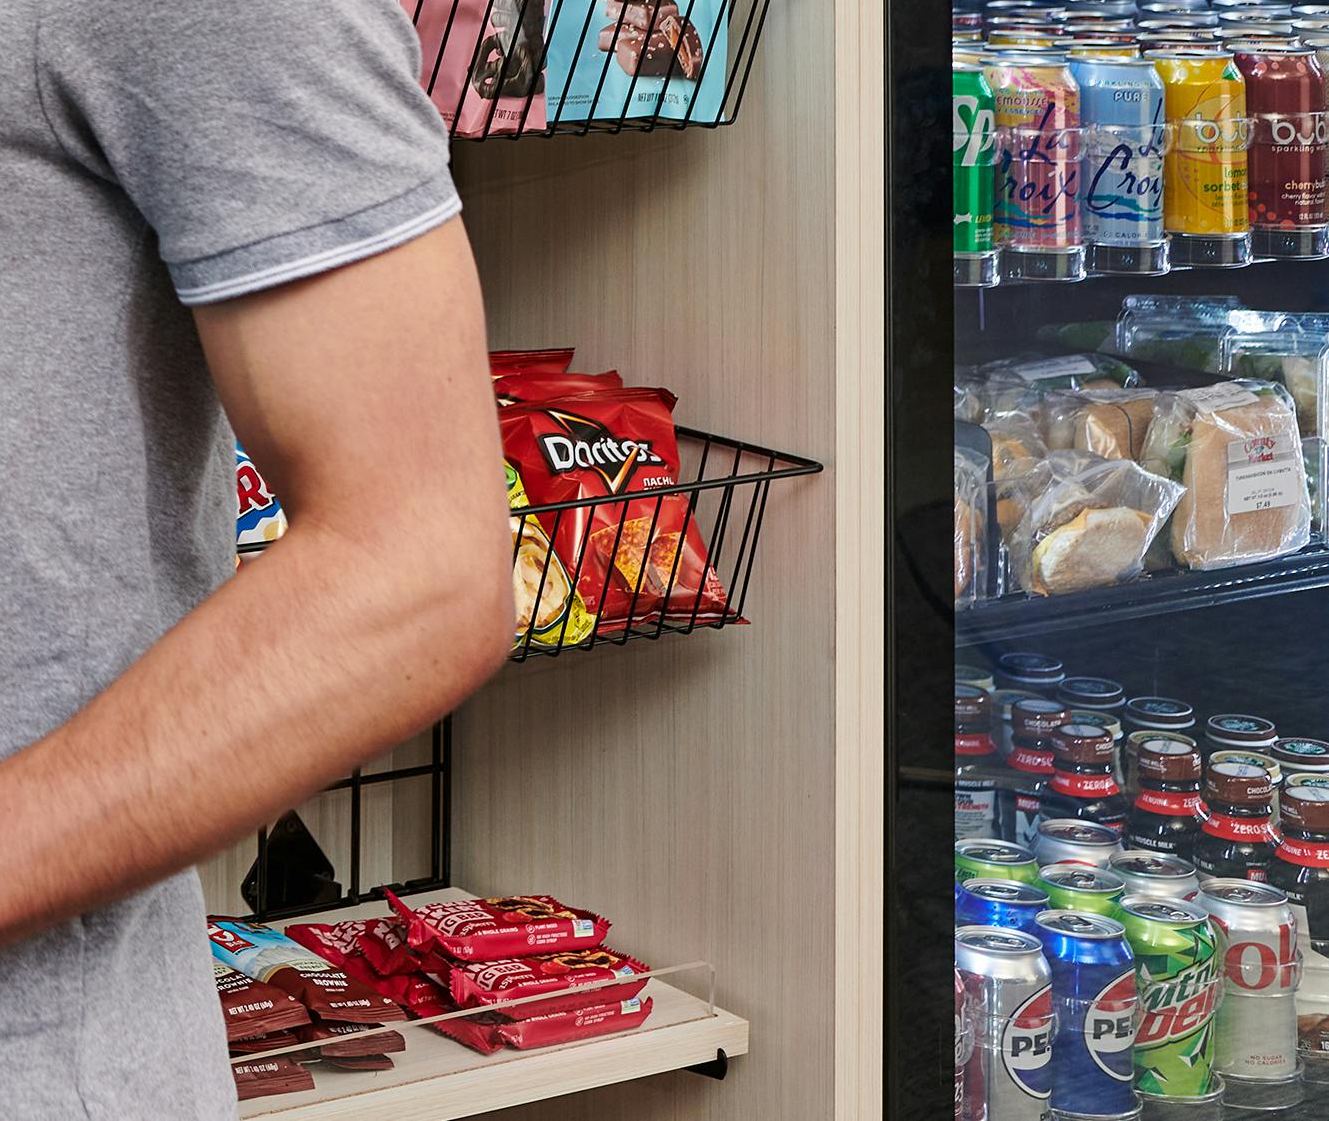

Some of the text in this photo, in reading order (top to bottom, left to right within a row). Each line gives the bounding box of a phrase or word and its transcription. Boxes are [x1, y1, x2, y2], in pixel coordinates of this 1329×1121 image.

[1113, 92, 1149, 103] PURE
[1271, 145, 1315, 154] sparkling
[543, 435, 663, 471] Doritos
[1232, 823, 1261, 835] ZERO
[1158, 841, 1175, 850] MILK
[457, 911, 489, 921] BAR
[499, 926, 519, 934] GRAINS
[496, 964, 525, 973] BAR
[313, 978, 349, 987] BROWNIE
[228, 1007, 238, 1016] NET
